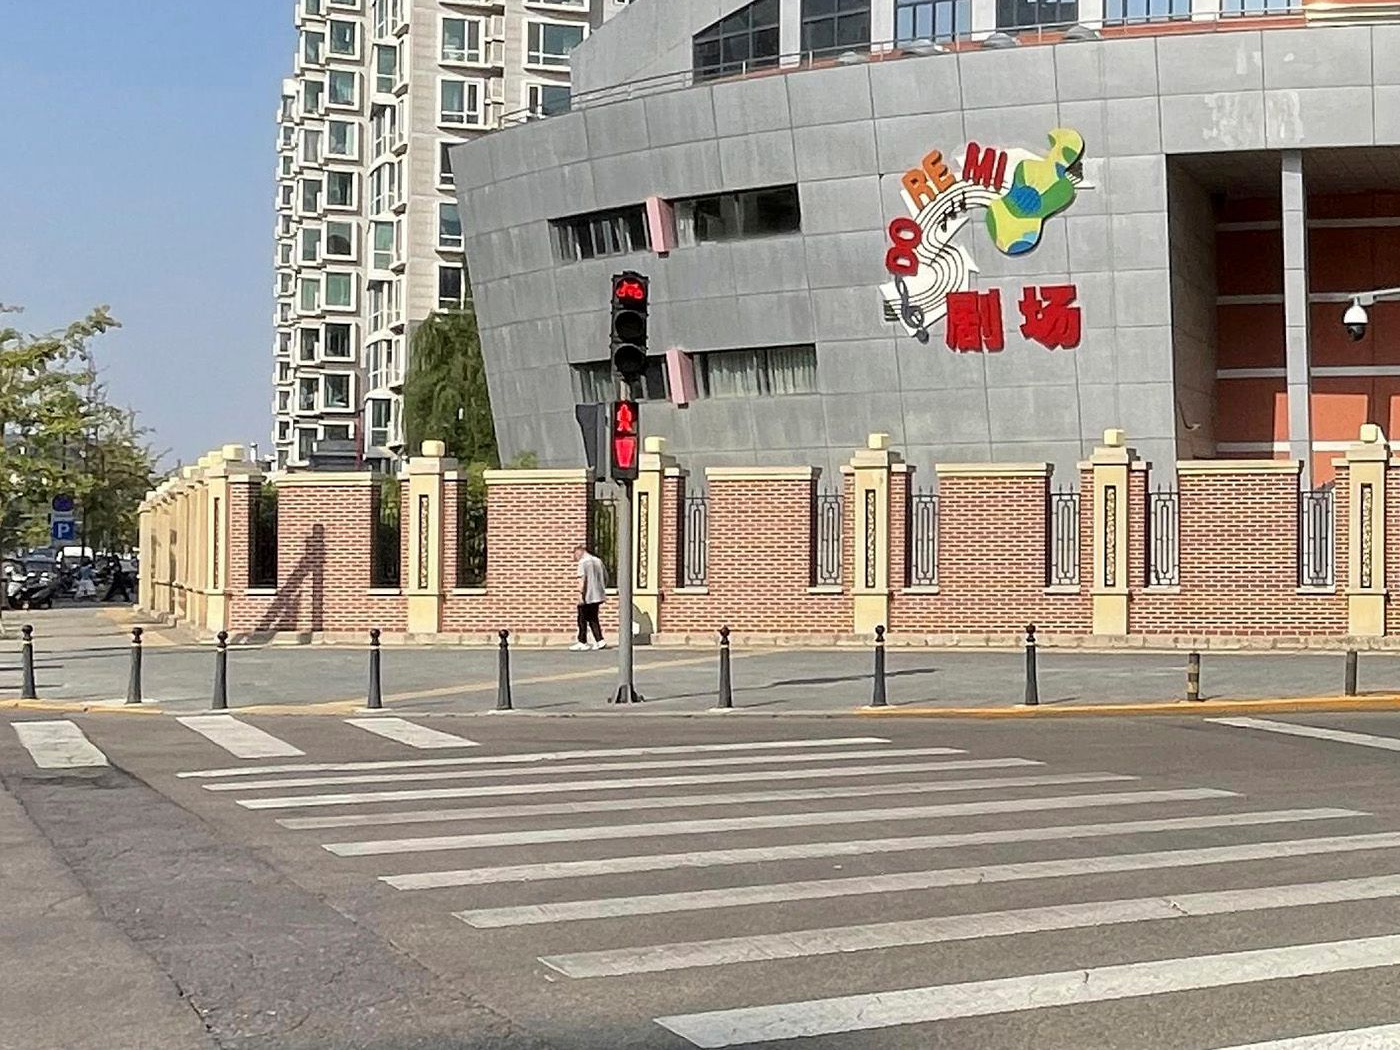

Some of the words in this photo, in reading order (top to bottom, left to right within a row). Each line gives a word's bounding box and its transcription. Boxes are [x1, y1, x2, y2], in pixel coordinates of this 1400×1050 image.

[901, 150, 957, 211] RE
[963, 142, 1008, 191] MI
[886, 218, 922, 276] DO
[945, 285, 1082, 352] 剧场
[57, 523, 70, 539] P
